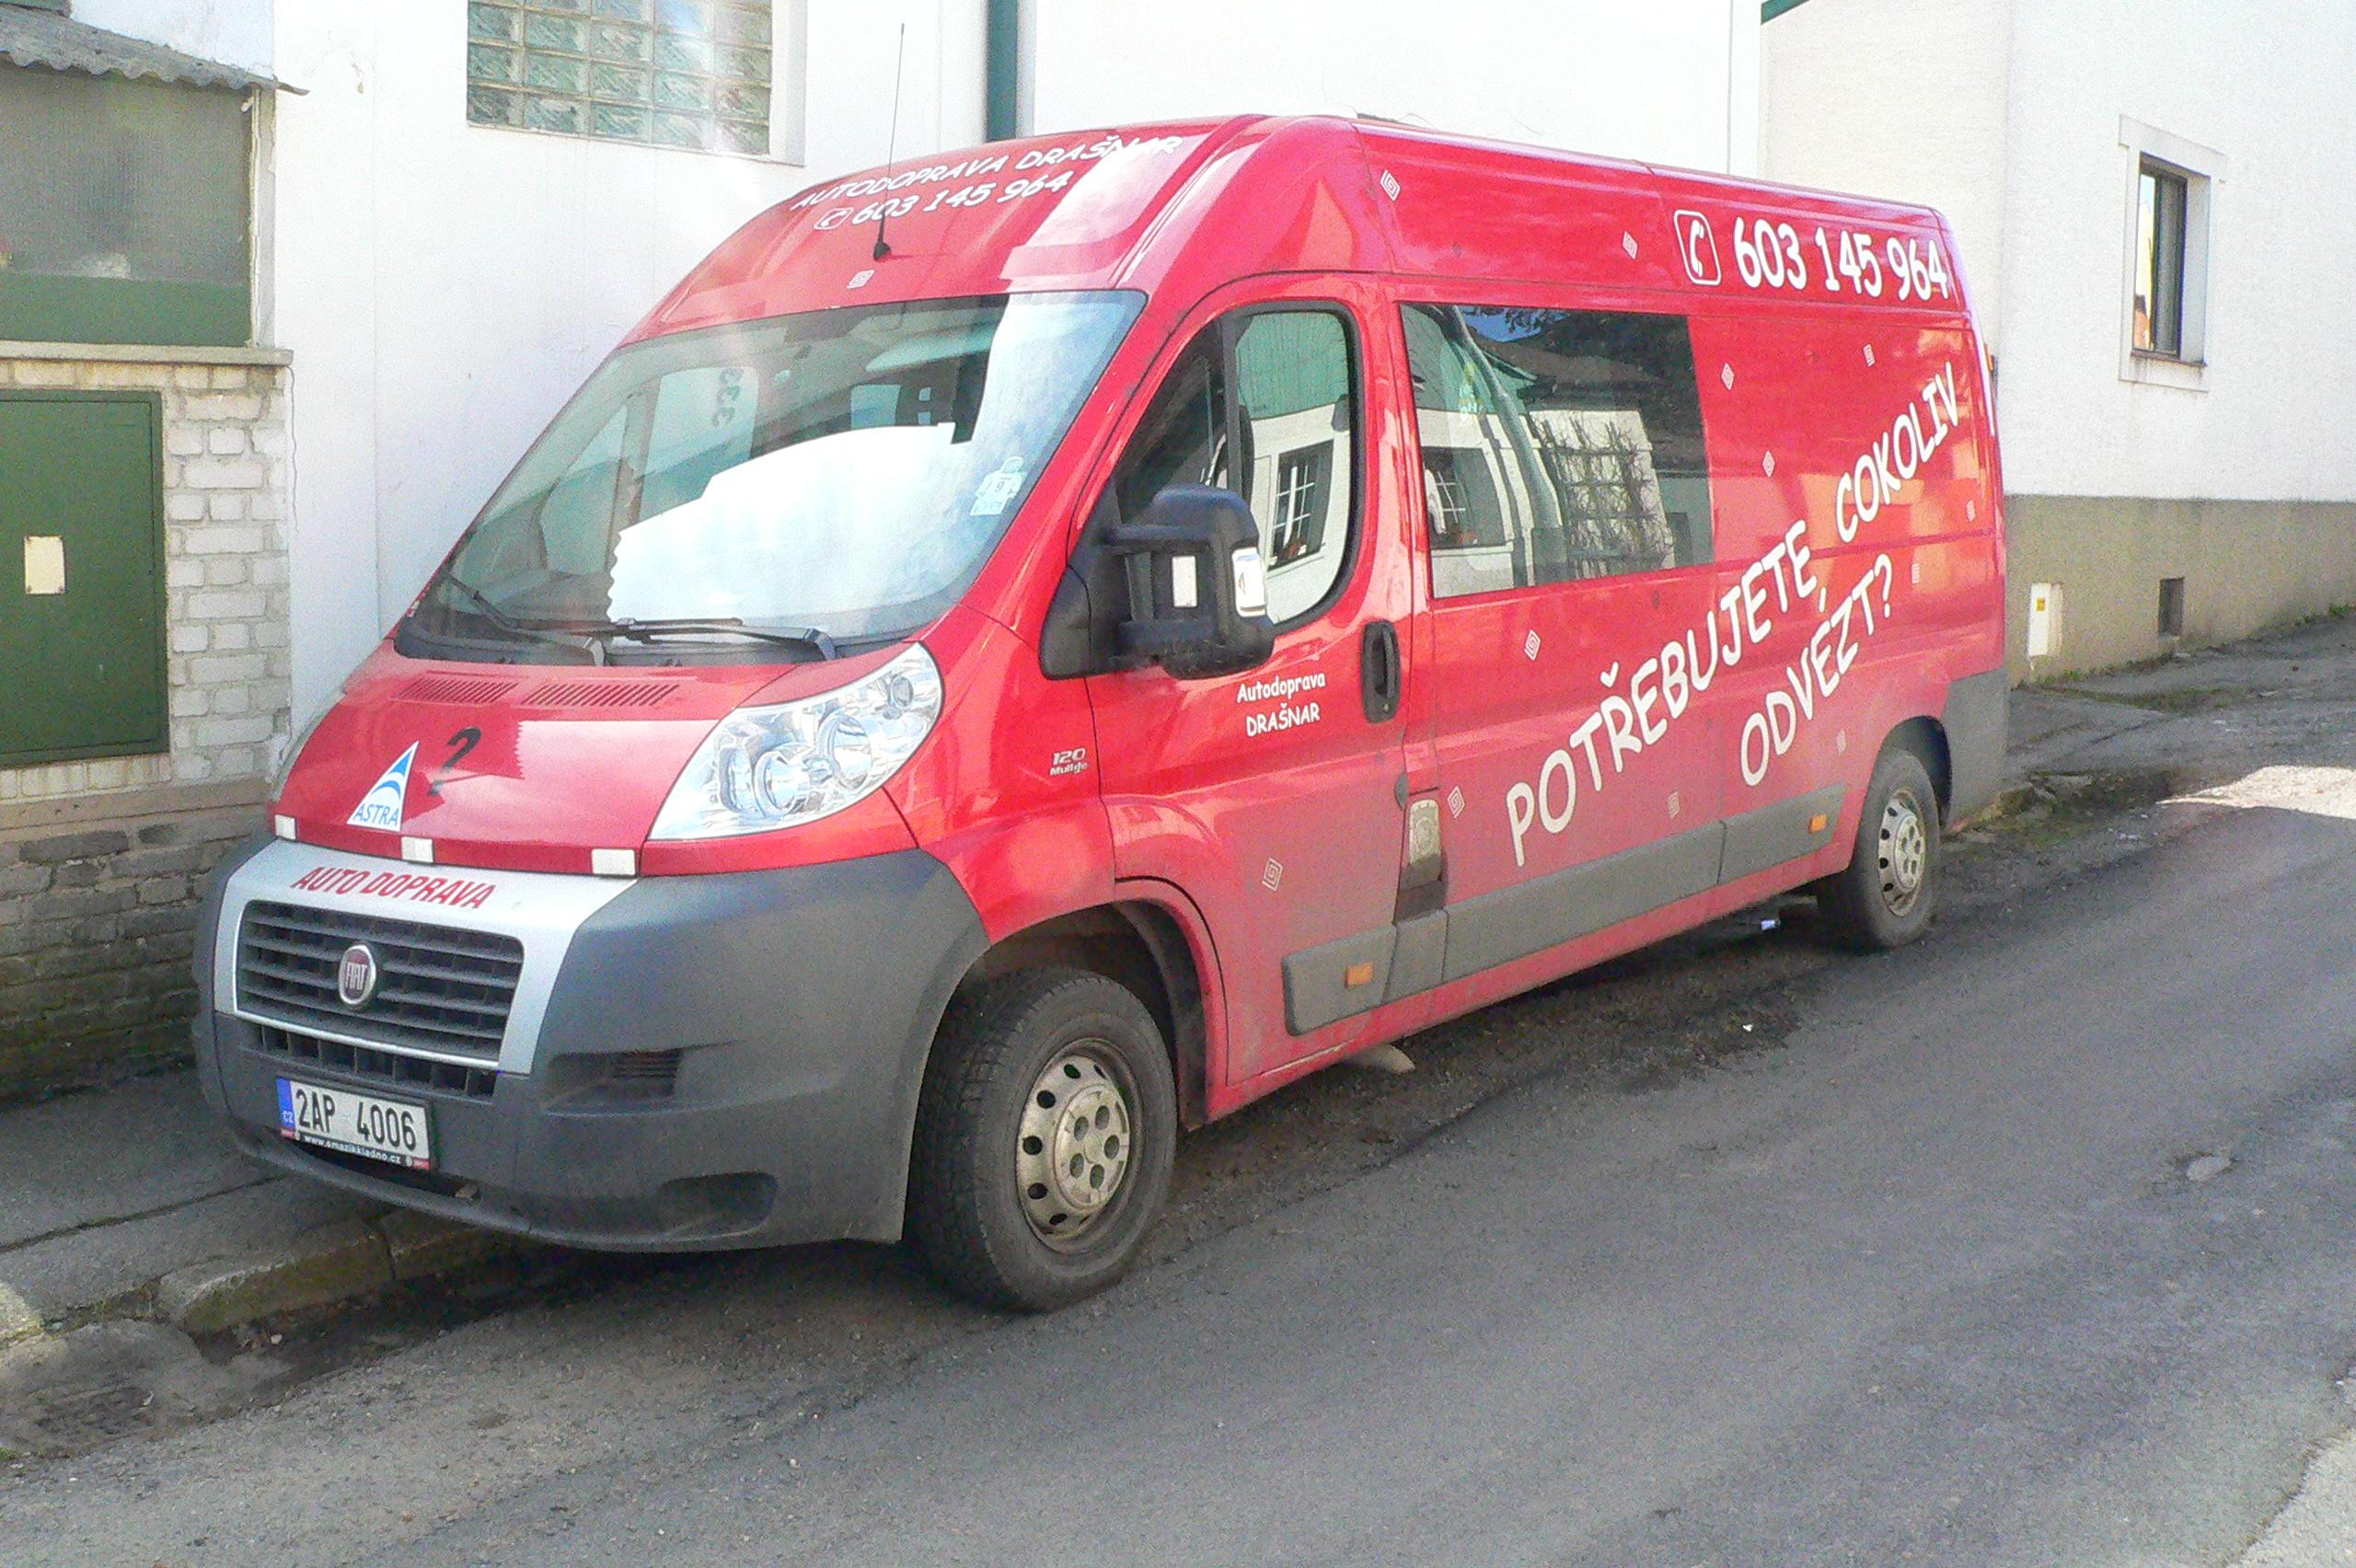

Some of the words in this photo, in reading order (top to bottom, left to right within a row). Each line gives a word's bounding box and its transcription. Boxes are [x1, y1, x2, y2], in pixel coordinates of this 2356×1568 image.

[790, 156, 1010, 212] AUTODOPRAVA
[1015, 135, 1184, 170] DRAŠNR
[851, 195, 920, 225] 603
[922, 183, 998, 213] 145
[997, 170, 1075, 203] 964
[1732, 215, 1807, 291] 603
[1813, 225, 1883, 298] 145
[1886, 236, 1949, 301] 964
[1505, 519, 1819, 867] POTŘEBUJETE
[1834, 361, 1959, 543] COKOLIV
[1236, 673, 1326, 704] Autodoprava
[1739, 553, 1893, 787] ODVÉZT?
[1245, 702, 1322, 737] DRAŠNAR
[1052, 747, 1086, 766] 120
[352, 803, 400, 826] ASTRA
[290, 866, 371, 895] AUTO
[360, 872, 497, 909] DOPRAVA
[345, 962, 368, 991] FIAT
[282, 1110, 294, 1124] CZ
[294, 1088, 337, 1134] 2AP
[356, 1101, 417, 1151] 4006
